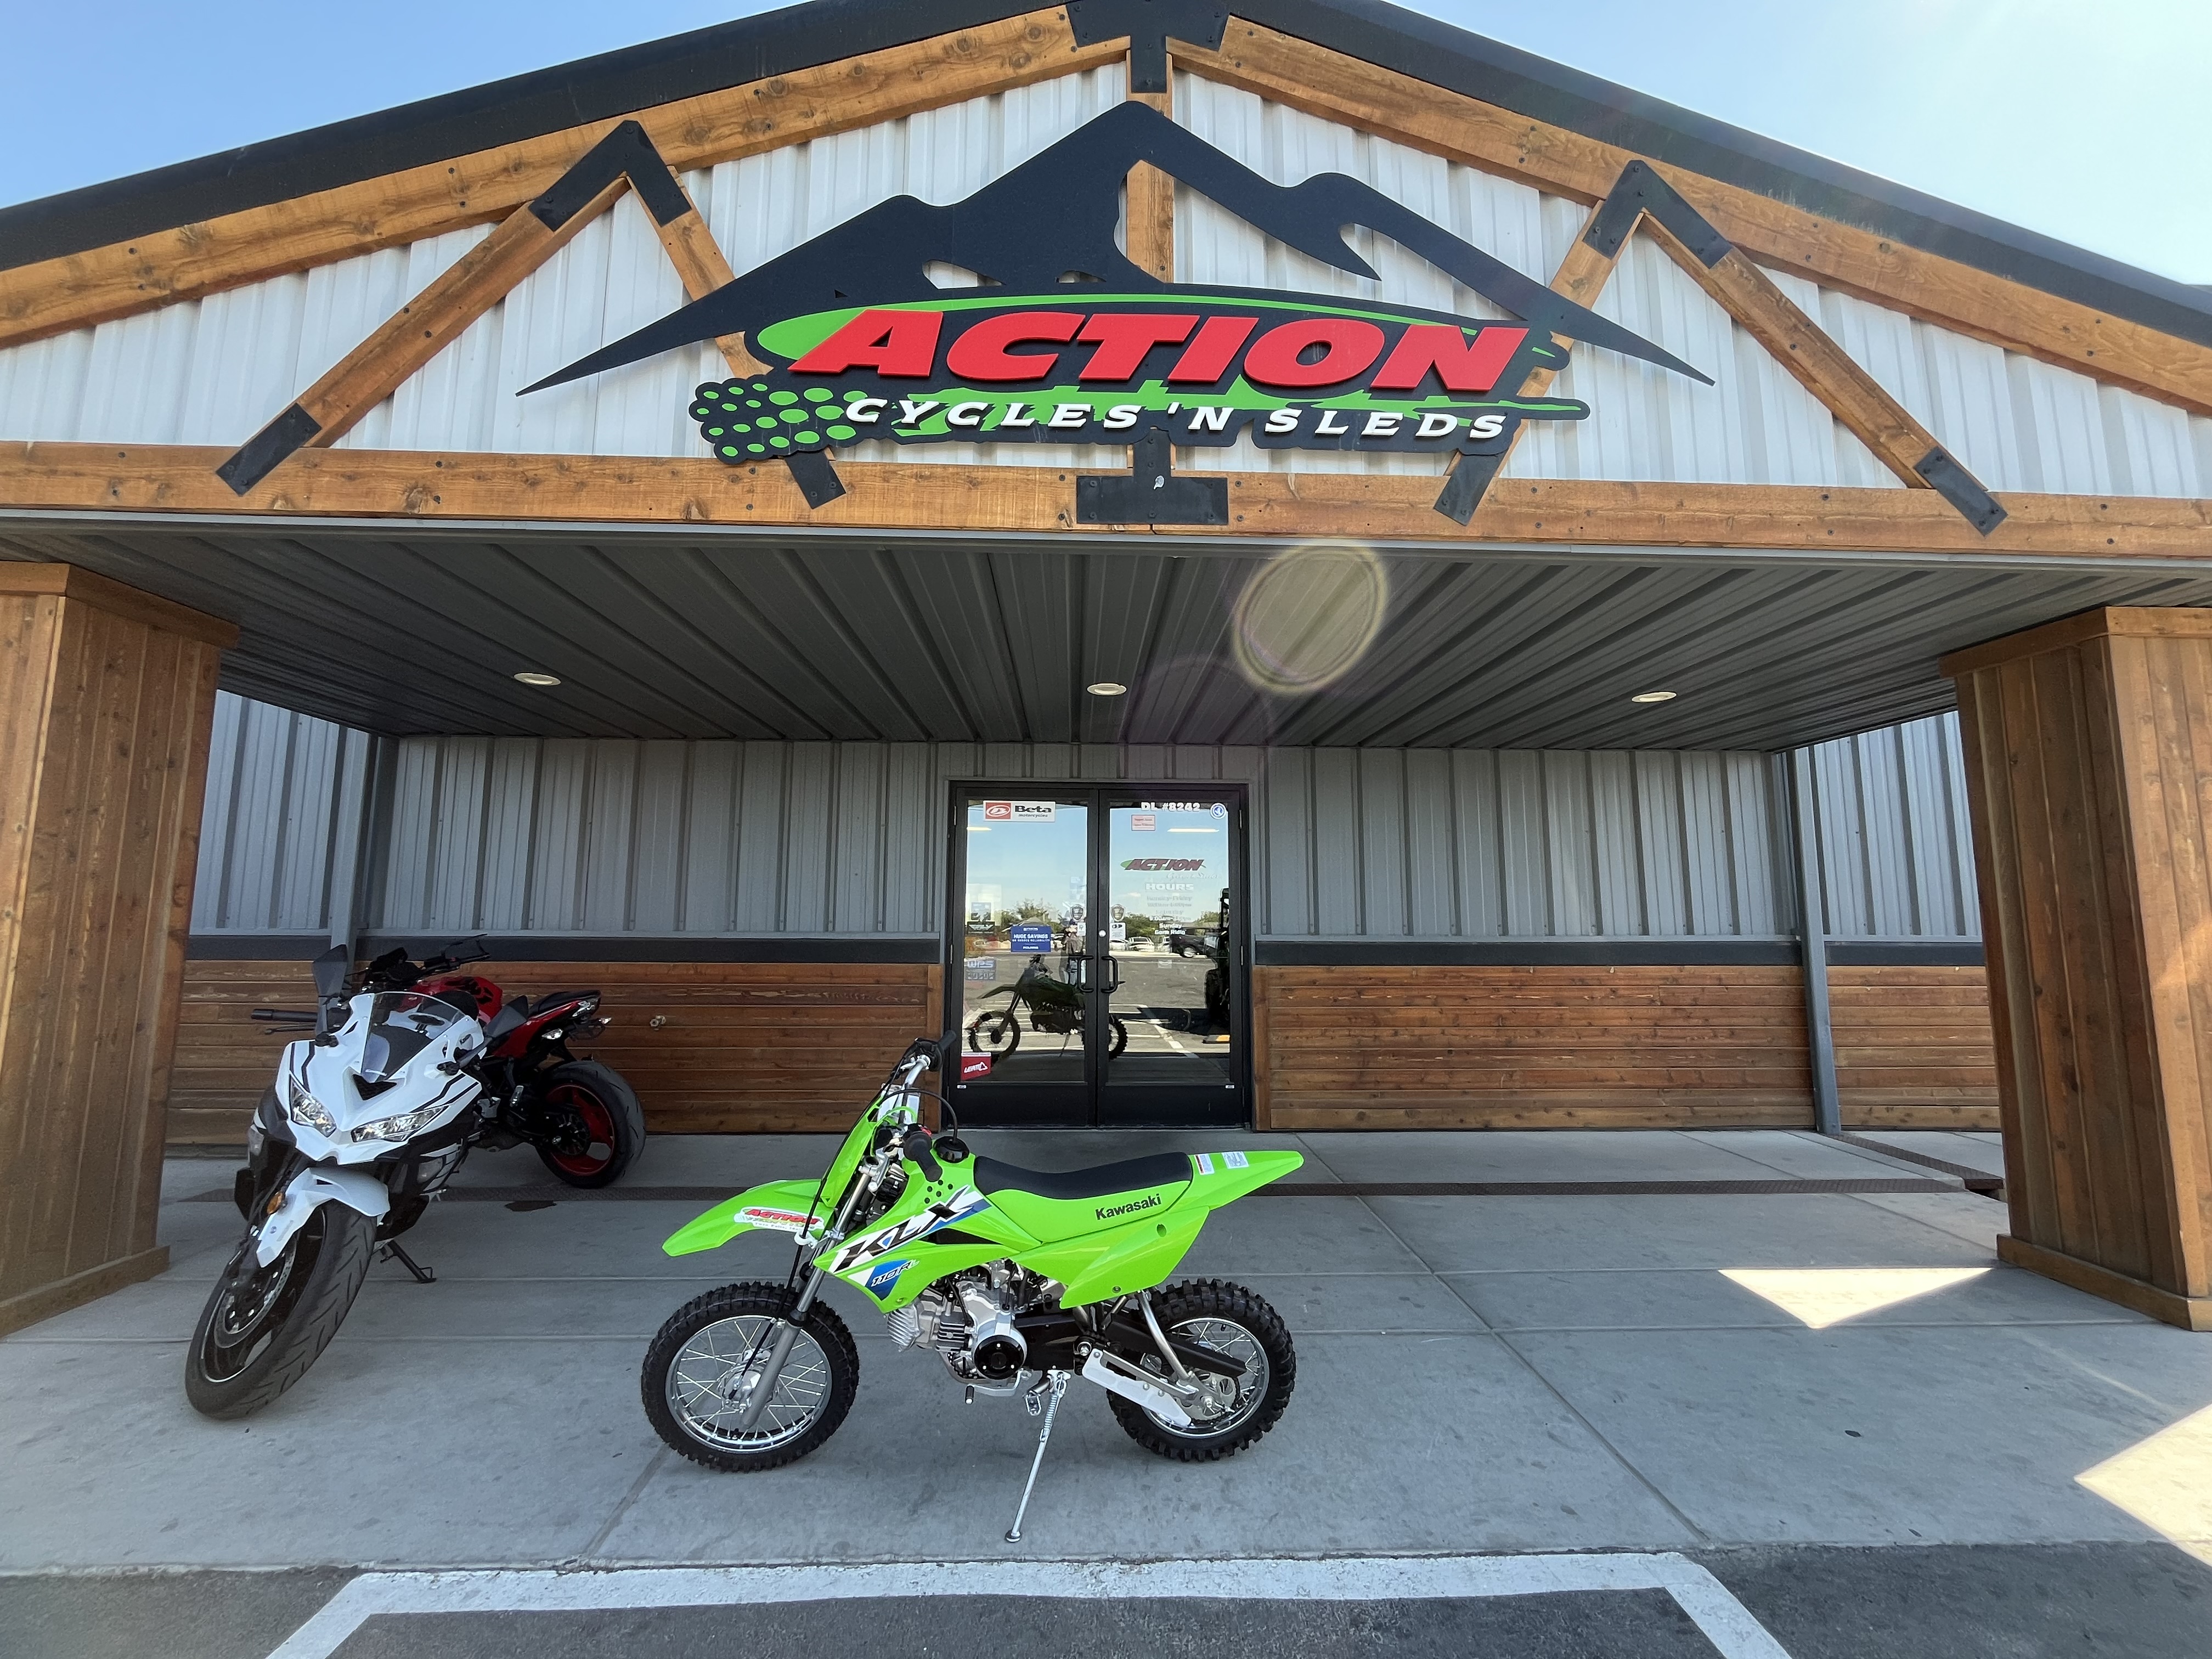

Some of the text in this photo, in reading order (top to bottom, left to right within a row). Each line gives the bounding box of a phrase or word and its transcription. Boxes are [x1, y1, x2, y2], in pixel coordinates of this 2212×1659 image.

[787, 308, 1529, 391] ACTION
[845, 398, 1142, 429] CYCLES
[1265, 408, 1507, 439] SLEDS
[1141, 802, 1158, 811] DL
[1162, 802, 1200, 812] #8242
[1125, 859, 1205, 871] ACTION
[744, 1209, 821, 1225] ACTION
[1095, 1193, 1162, 1220] Kawasaki
[831, 1185, 974, 1273] KLX
